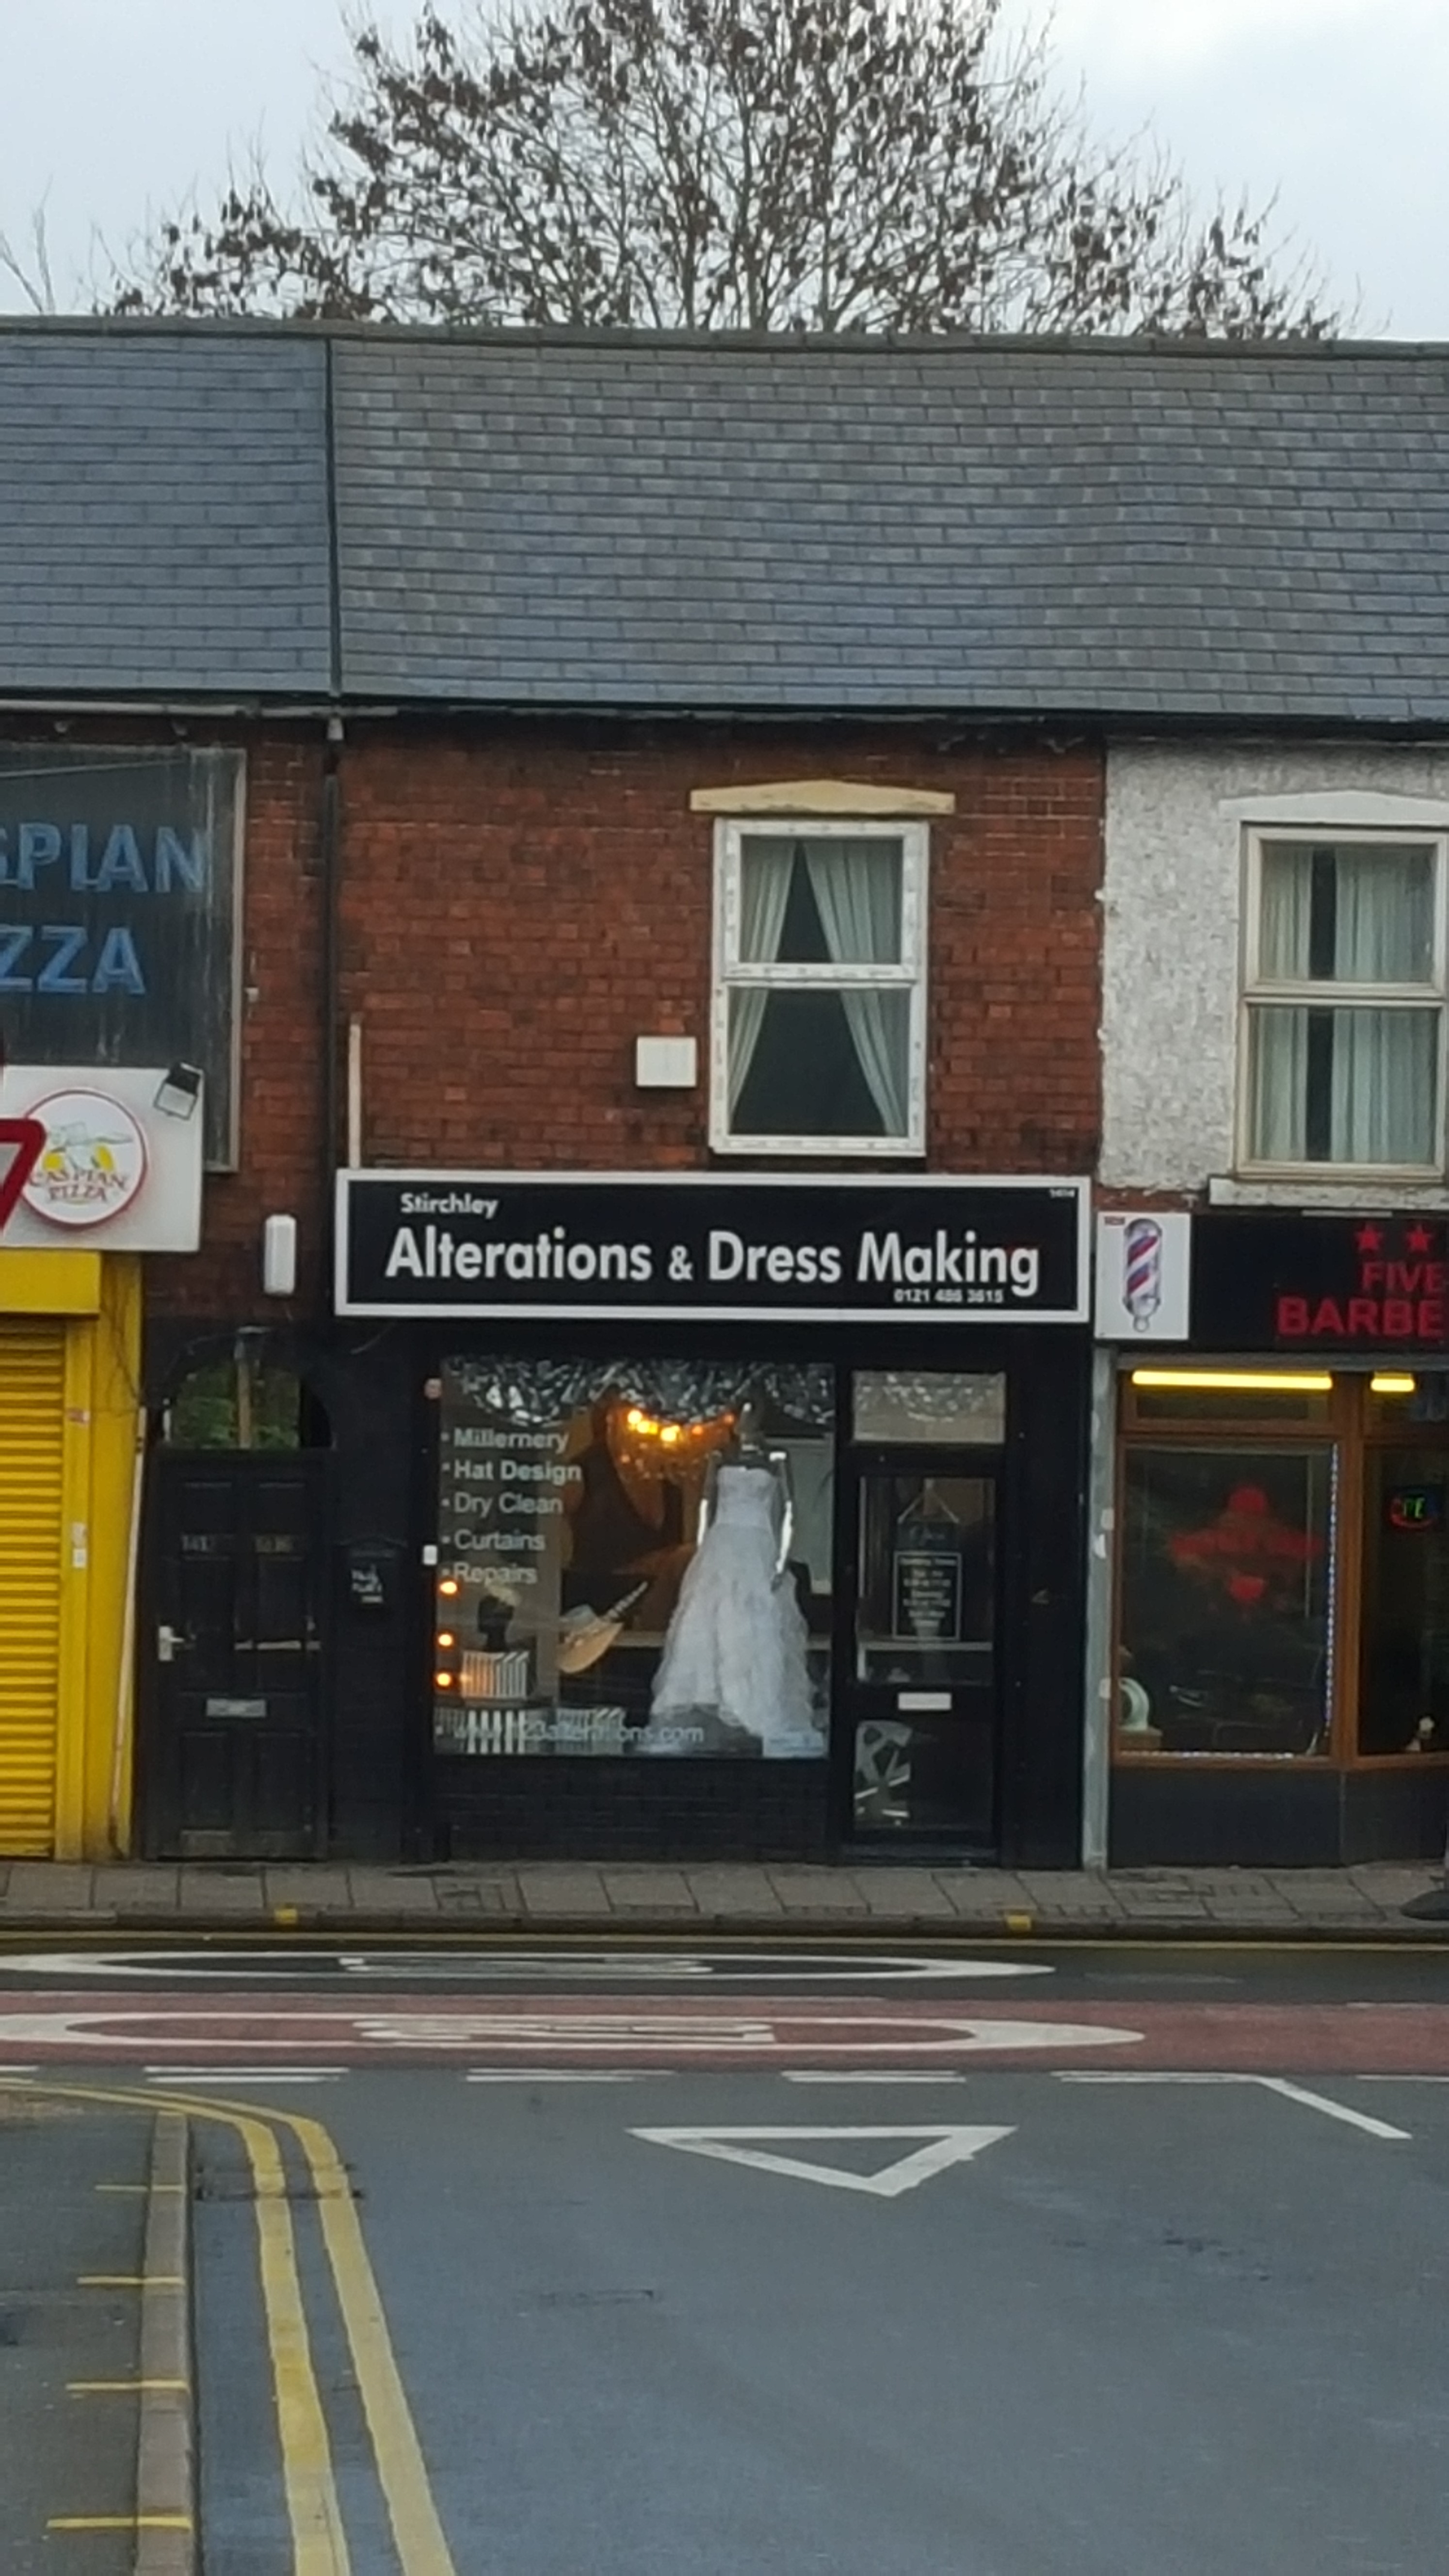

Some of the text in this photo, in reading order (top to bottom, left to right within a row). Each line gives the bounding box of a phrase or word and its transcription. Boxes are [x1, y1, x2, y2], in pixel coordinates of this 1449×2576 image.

[0, 823, 206, 893] PIAN
[400, 1192, 498, 1219] Stirchley
[385, 1224, 1039, 1297] Alterations & Dress Making
[1361, 1261, 1444, 1293] FIVE
[894, 1288, 931, 1303] 0121
[1277, 1296, 1445, 1338] BARBE
[454, 1460, 581, 1485] Hat Design
[454, 1492, 563, 1516] Dry Clean
[454, 1529, 546, 1550] Curtains
[454, 1562, 537, 1585] Repairs
